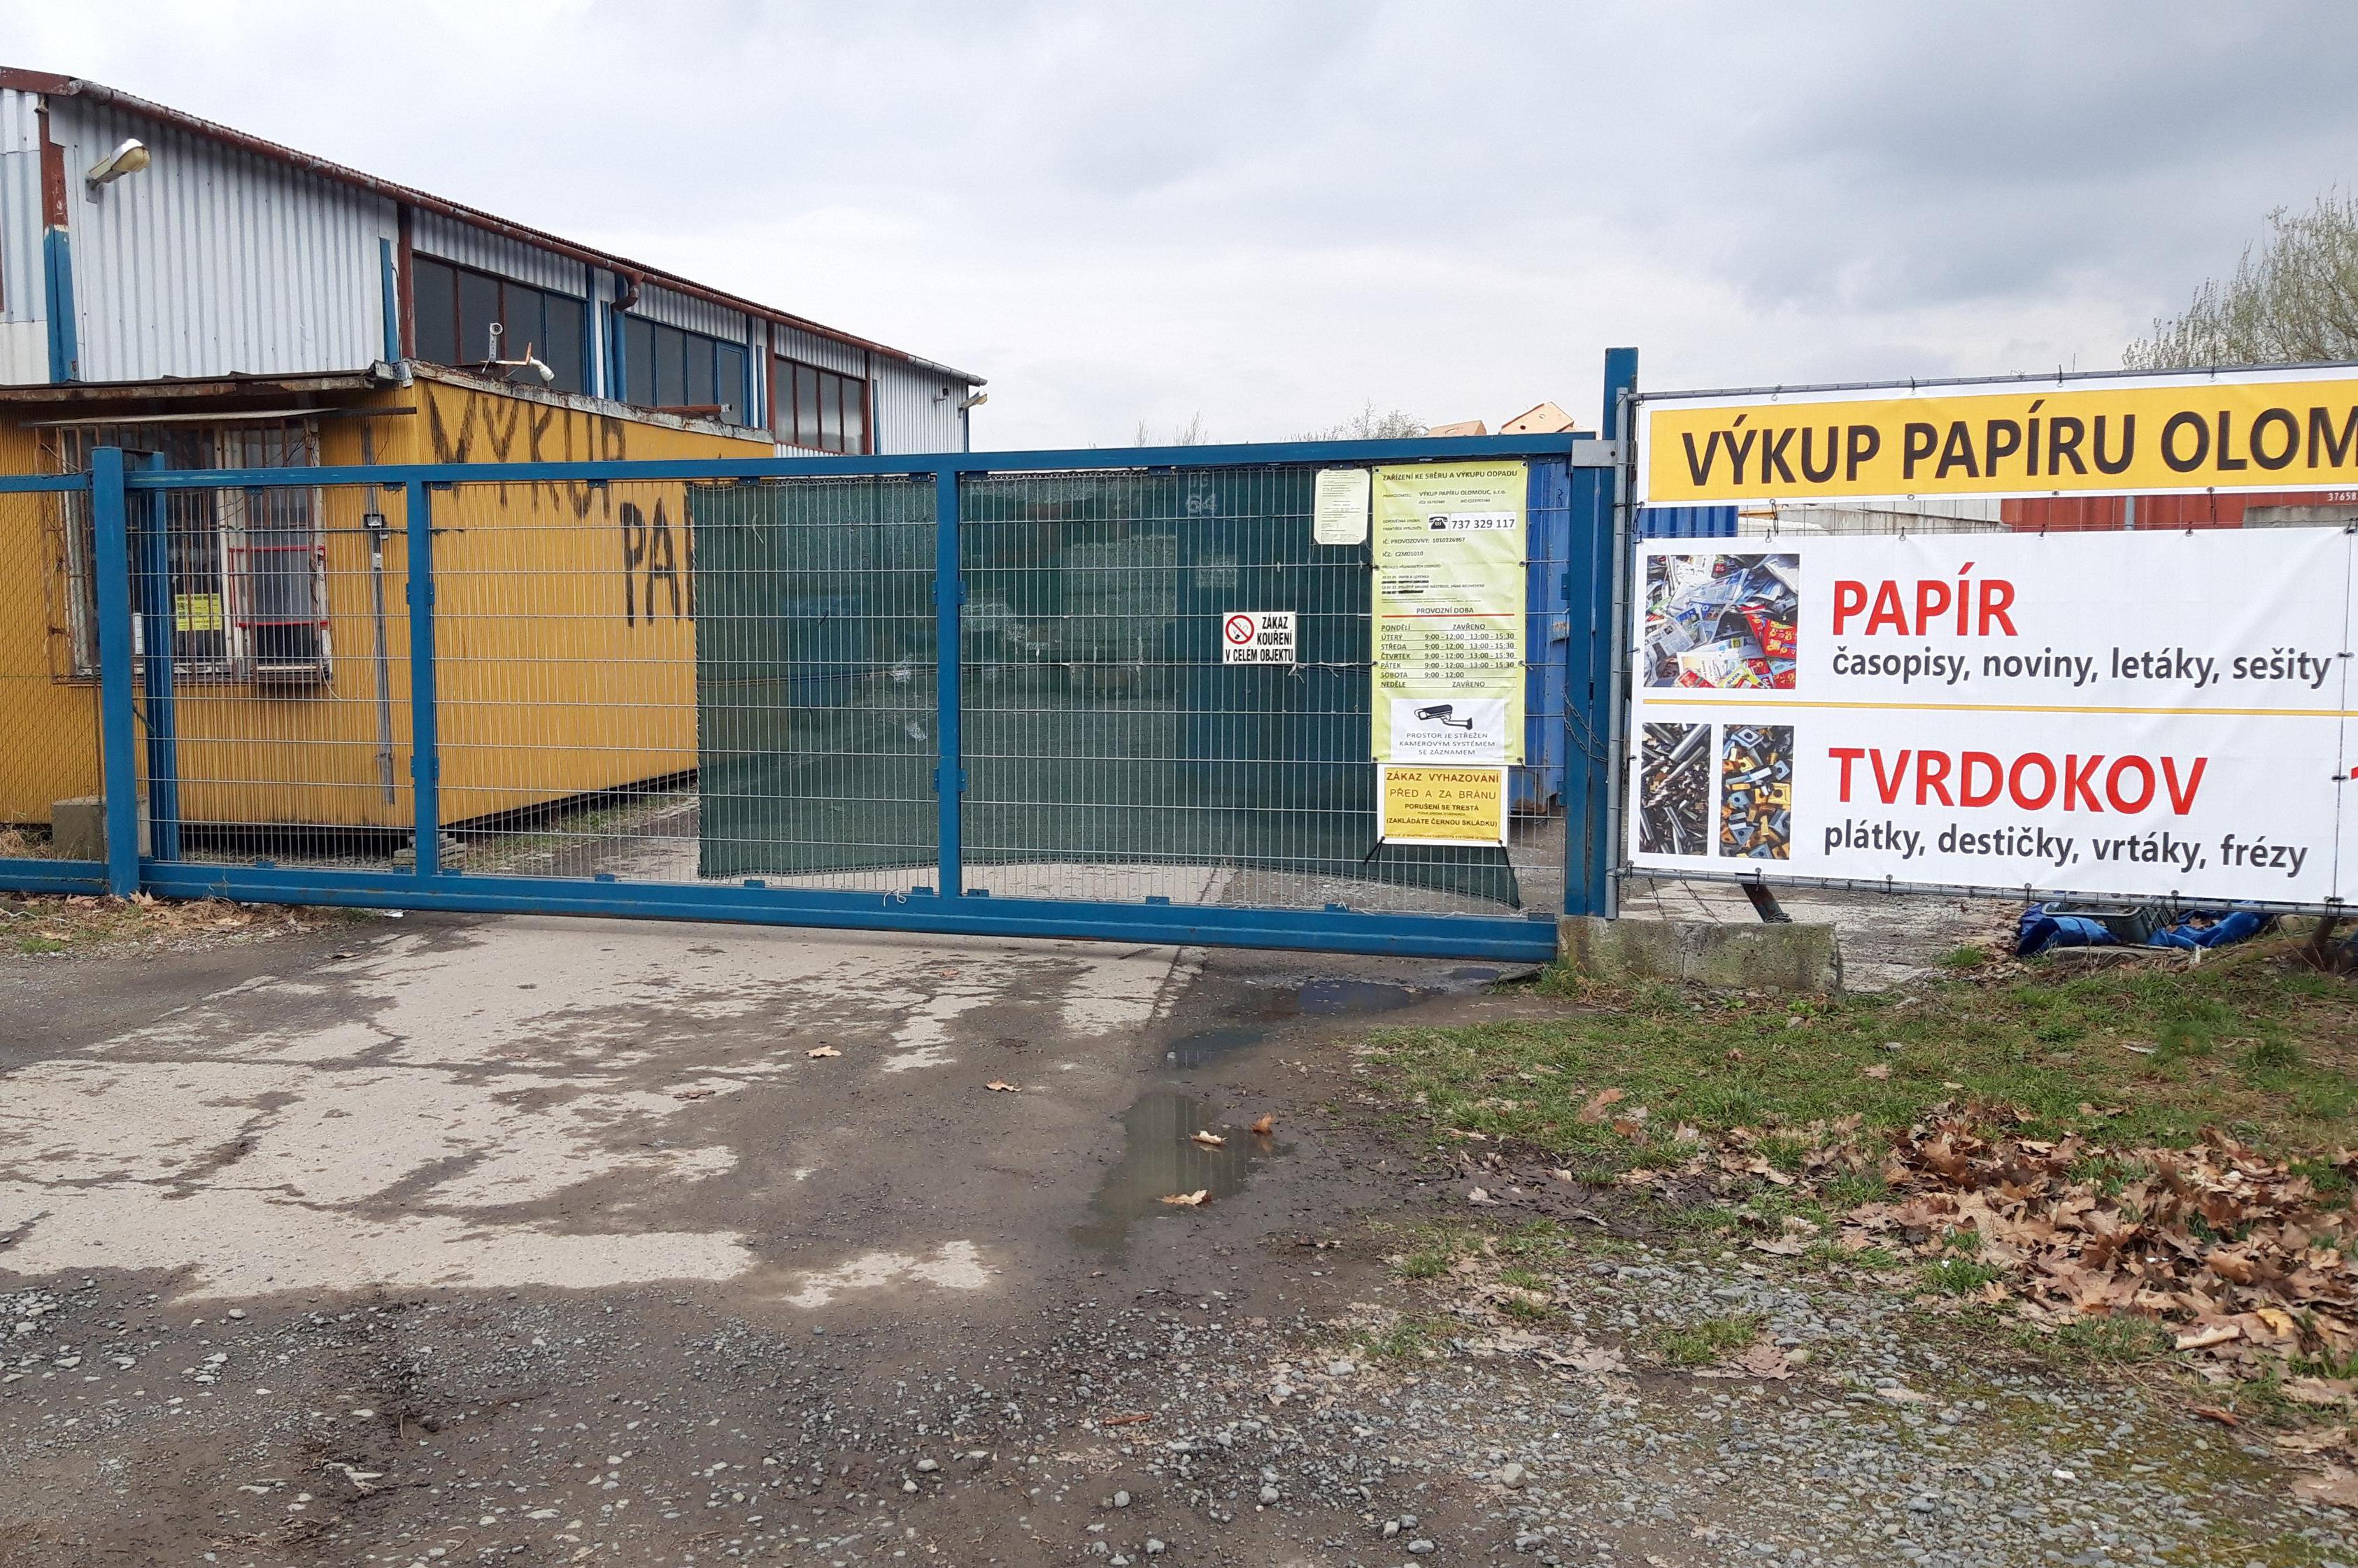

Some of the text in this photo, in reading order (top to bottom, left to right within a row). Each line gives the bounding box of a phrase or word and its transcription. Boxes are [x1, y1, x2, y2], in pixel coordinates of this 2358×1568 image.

[1682, 399, 2358, 485] VÝKUP PAPÍRU OLOM
[1382, 472, 1414, 480] ZAŘÍZENÍ
[1451, 518, 1515, 529] 737 329 117
[1834, 563, 2017, 636] PAPÍR
[1262, 614, 1288, 629] ZÁKAZ
[1257, 629, 1292, 646] KOUŘENÍ
[1226, 646, 1293, 662] V CELÉM OBJEKTU
[1833, 646, 2331, 689] časopisy, noviny, letáky, sešity
[1386, 771, 1499, 783] ZÁKAZ VYHAZOVÁNÍ
[1830, 748, 2207, 814] TVRDOKOV
[1390, 788, 1419, 797] PŘED
[1459, 789, 1496, 799] BRÁNU
[1431, 816, 1460, 825] ČERNOU
[1462, 818, 1498, 827] SKLÁDKU)
[1825, 819, 2307, 877] plátky, destičky, vrtáky, frézy
